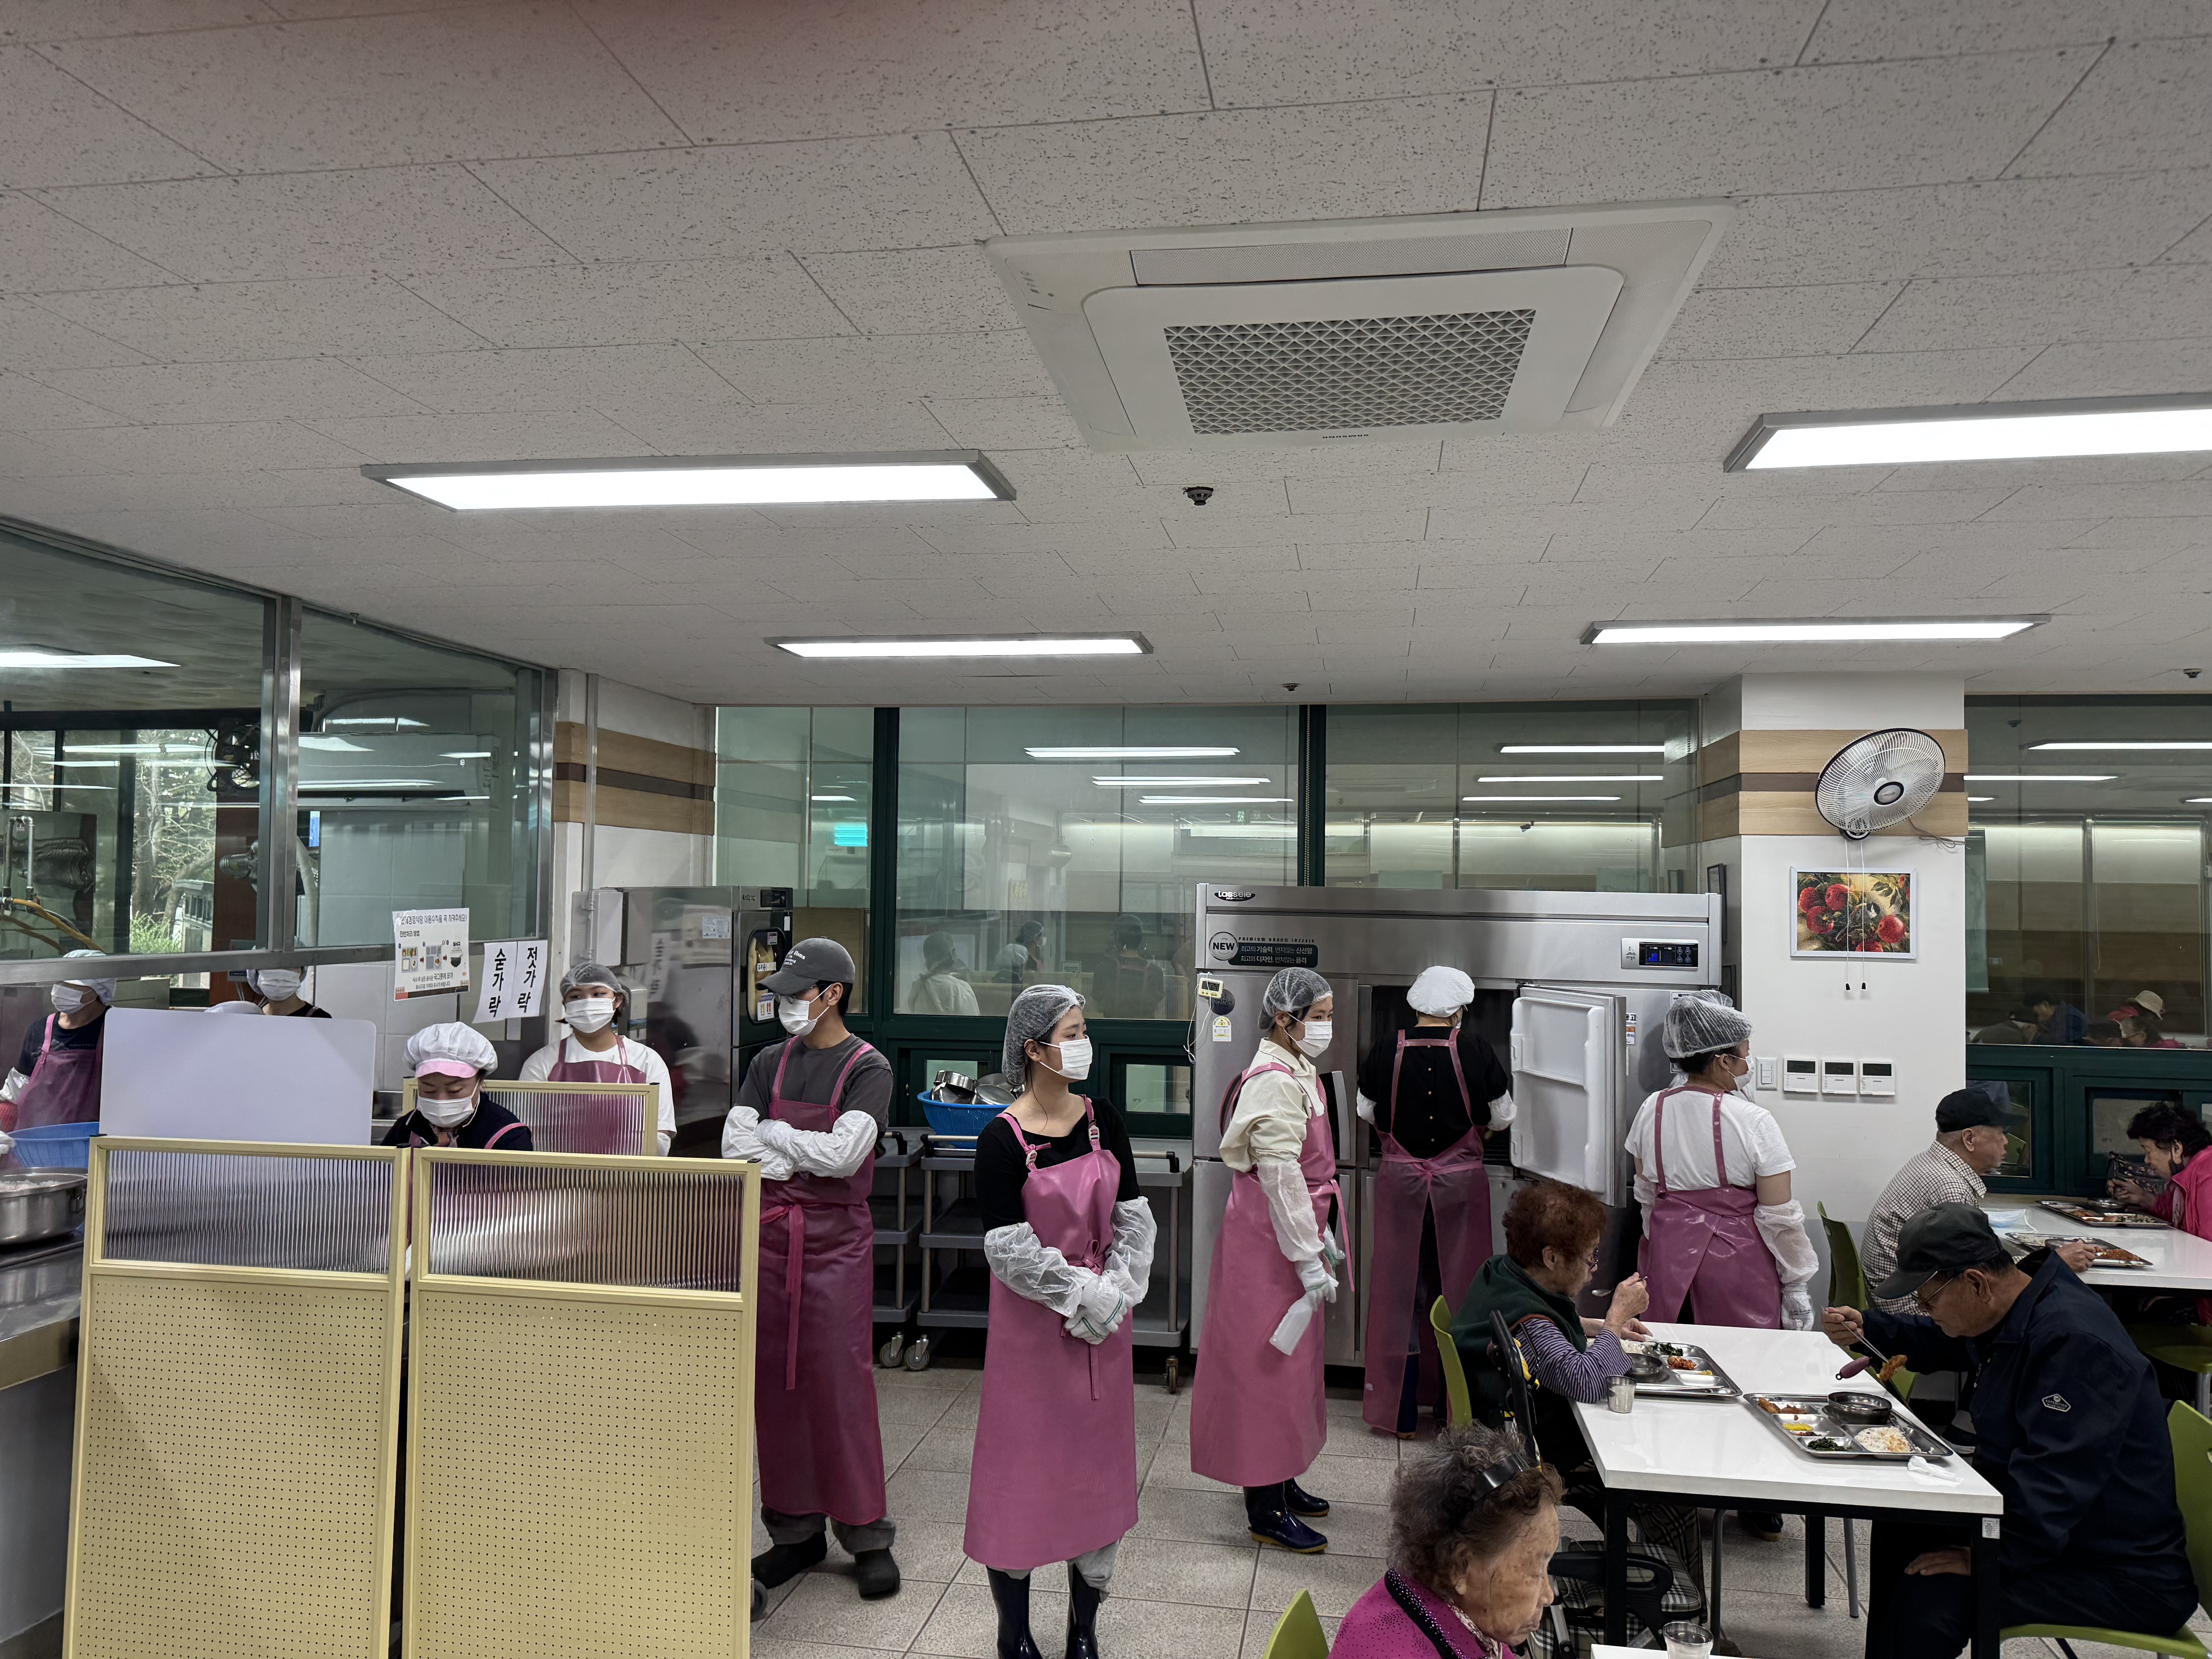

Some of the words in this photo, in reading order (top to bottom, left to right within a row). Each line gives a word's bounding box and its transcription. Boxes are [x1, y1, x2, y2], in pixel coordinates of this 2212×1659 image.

[517, 946, 538, 1013] 젓가락
[1212, 942, 1235, 950] NEW
[489, 948, 507, 1018] 숟가락
